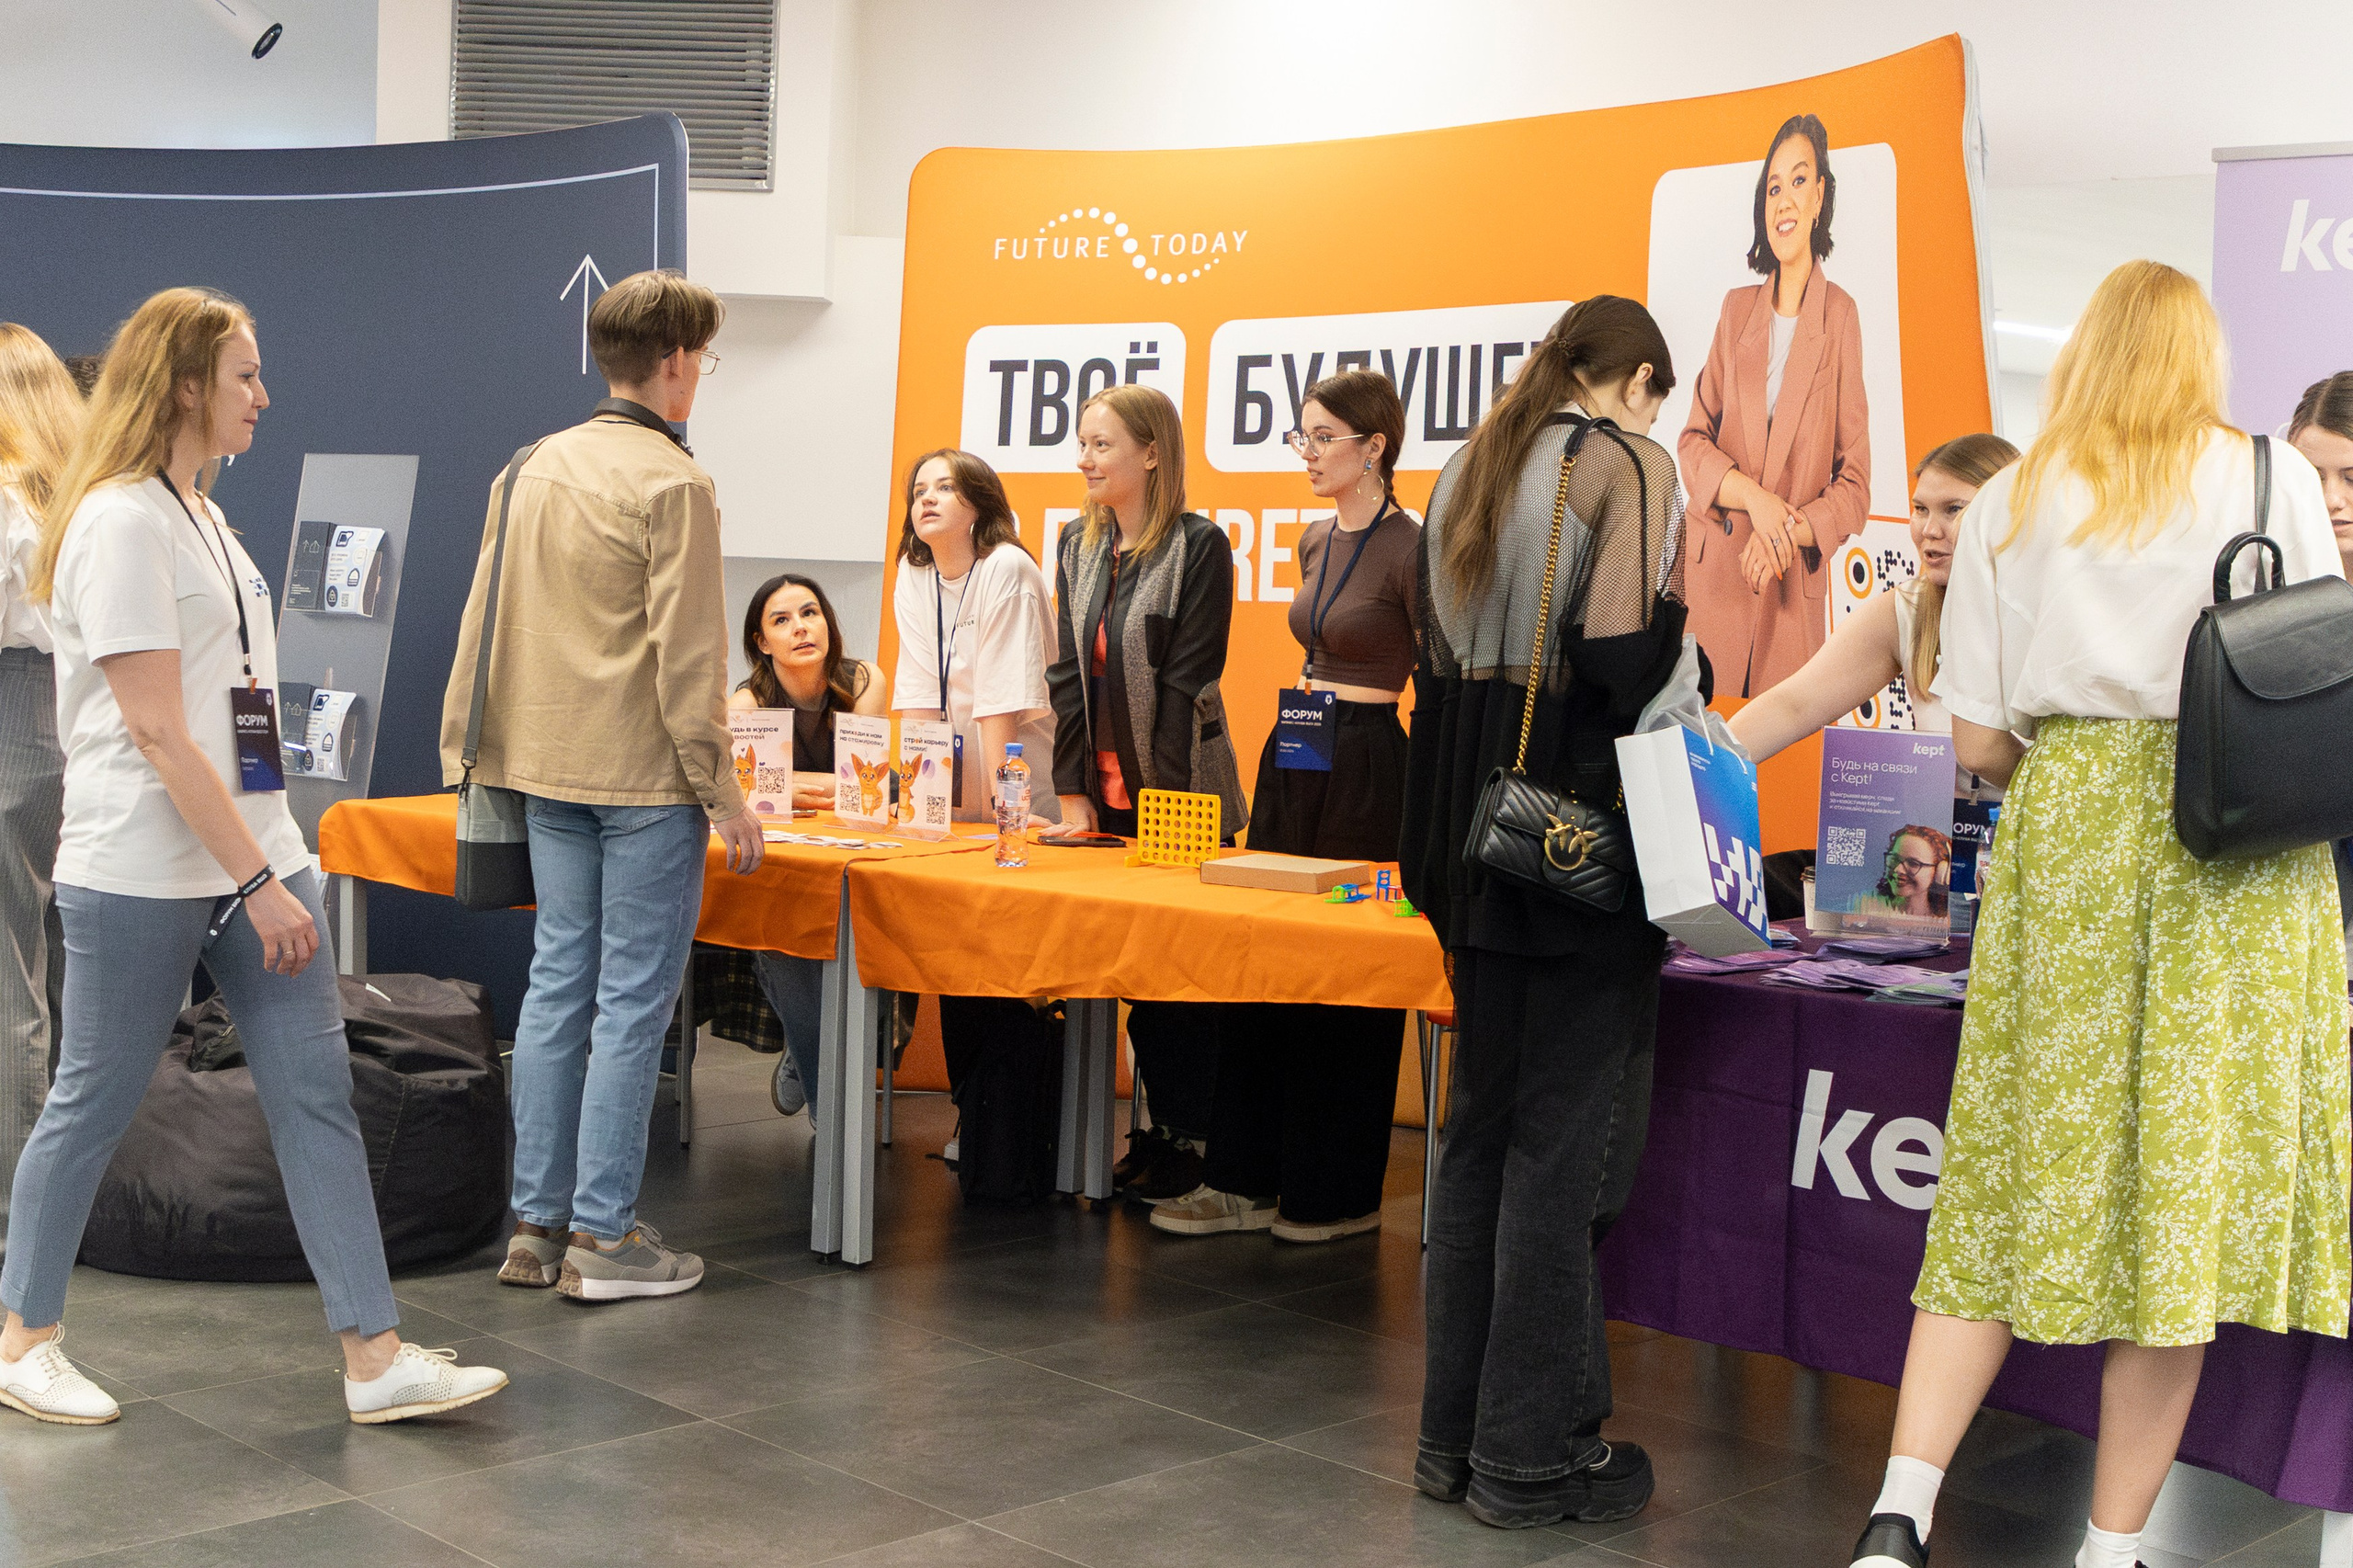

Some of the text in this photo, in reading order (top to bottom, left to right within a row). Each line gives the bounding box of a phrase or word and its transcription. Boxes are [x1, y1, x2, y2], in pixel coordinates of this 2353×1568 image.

[994, 230, 1248, 260] FUTURE TODAY
[235, 714, 268, 726] ФОРУМ
[1281, 709, 1323, 721] ФОРУМ
[924, 739, 949, 748] карьеру
[1913, 743, 1945, 758] kept
[1832, 757, 1917, 775] Будь на связи
[1831, 772, 1872, 786] с Kept!
[1953, 823, 1985, 835] ОРУ
[1791, 1069, 1945, 1210] ke
